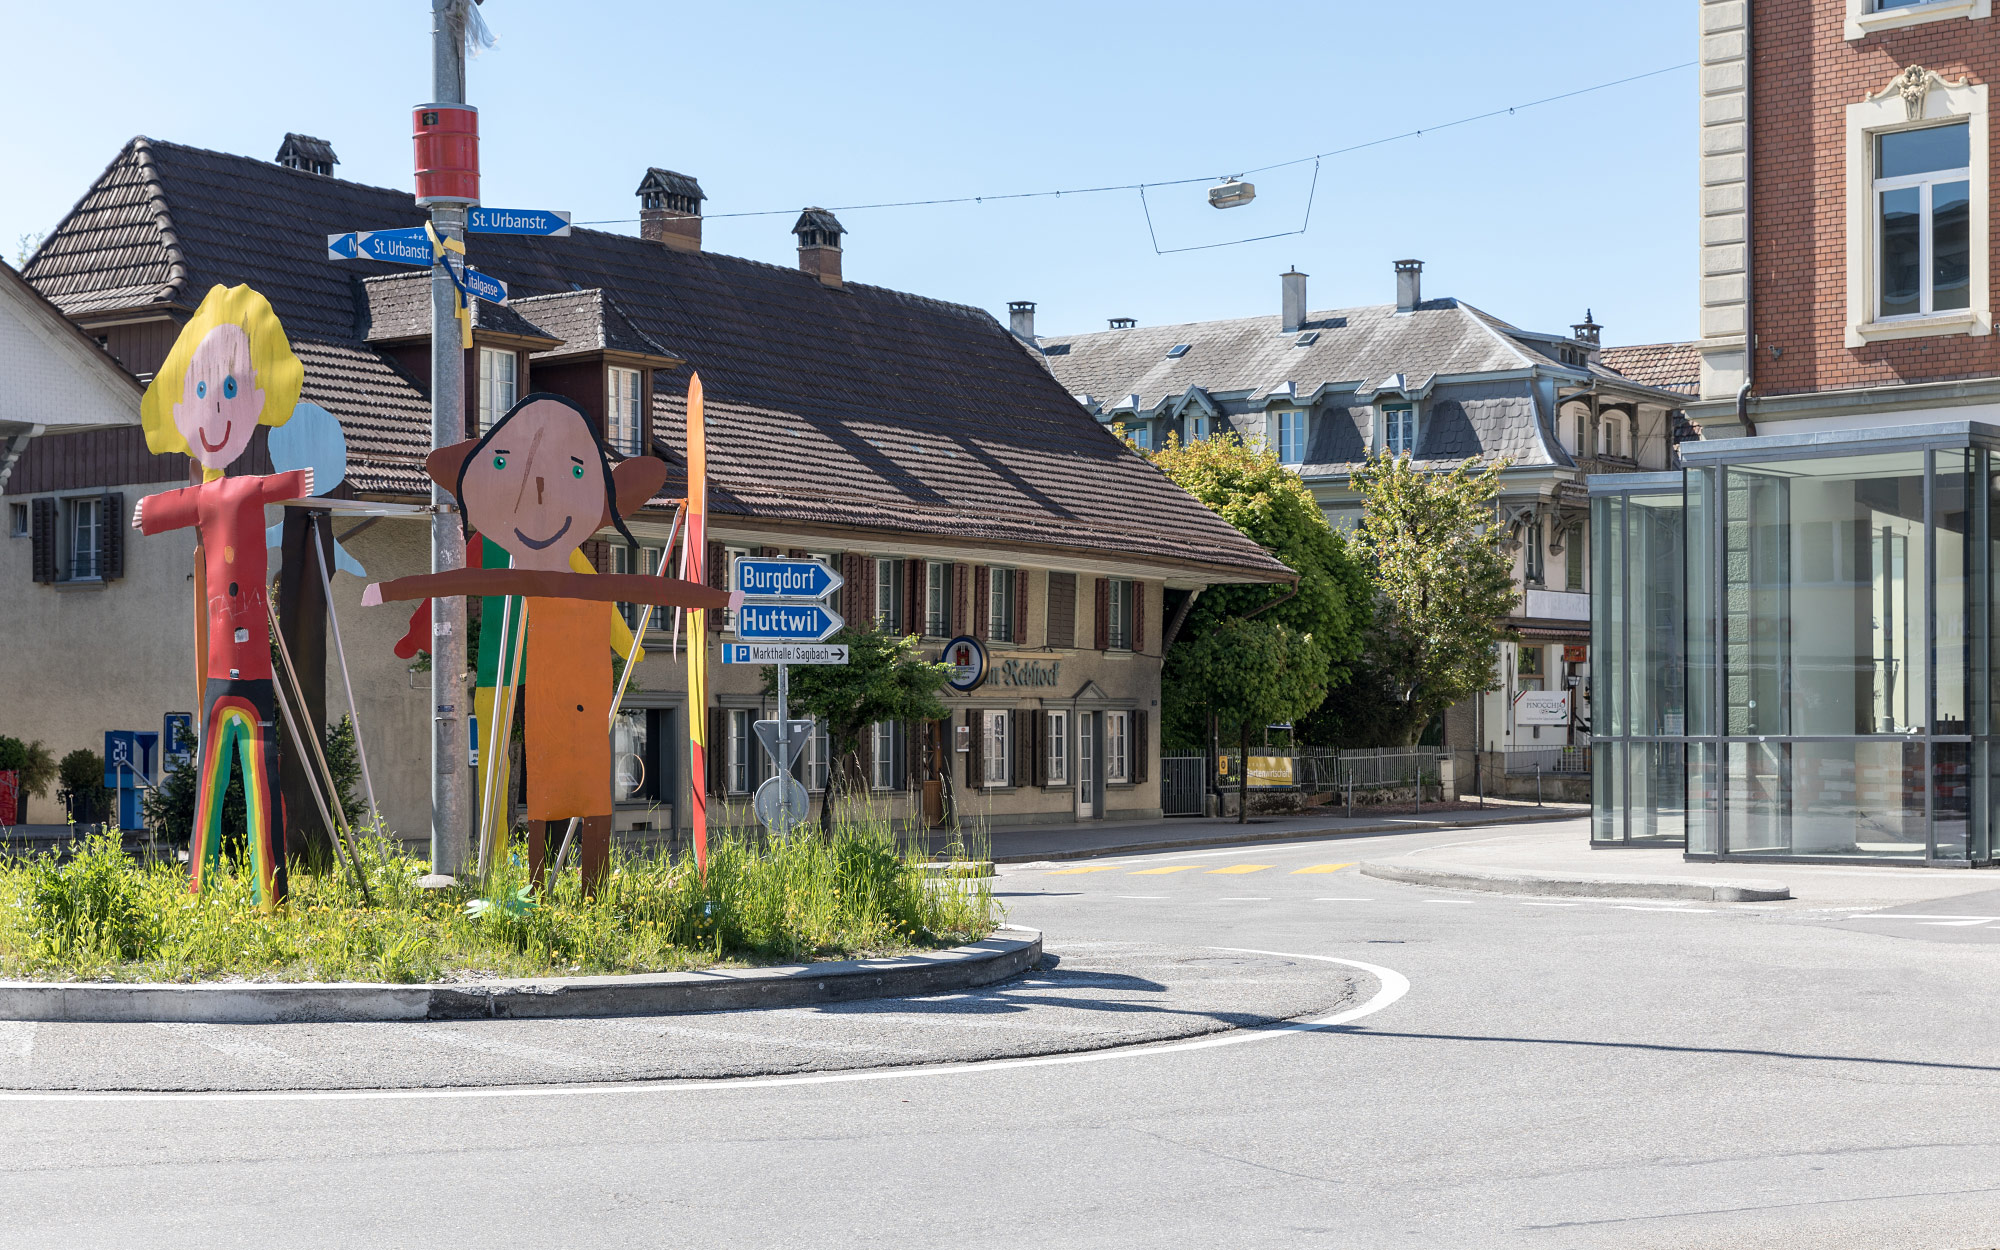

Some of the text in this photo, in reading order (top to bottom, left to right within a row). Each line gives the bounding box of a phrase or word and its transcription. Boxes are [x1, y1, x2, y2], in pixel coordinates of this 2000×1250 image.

[472, 211, 547, 229] St. Urbanstr.
[374, 238, 387, 255] St.
[388, 240, 431, 260] Urbanstr.
[743, 565, 816, 594] Burgdorf
[742, 608, 818, 632] Huttwil
[739, 647, 829, 662] P Markthalle/Sagibach
